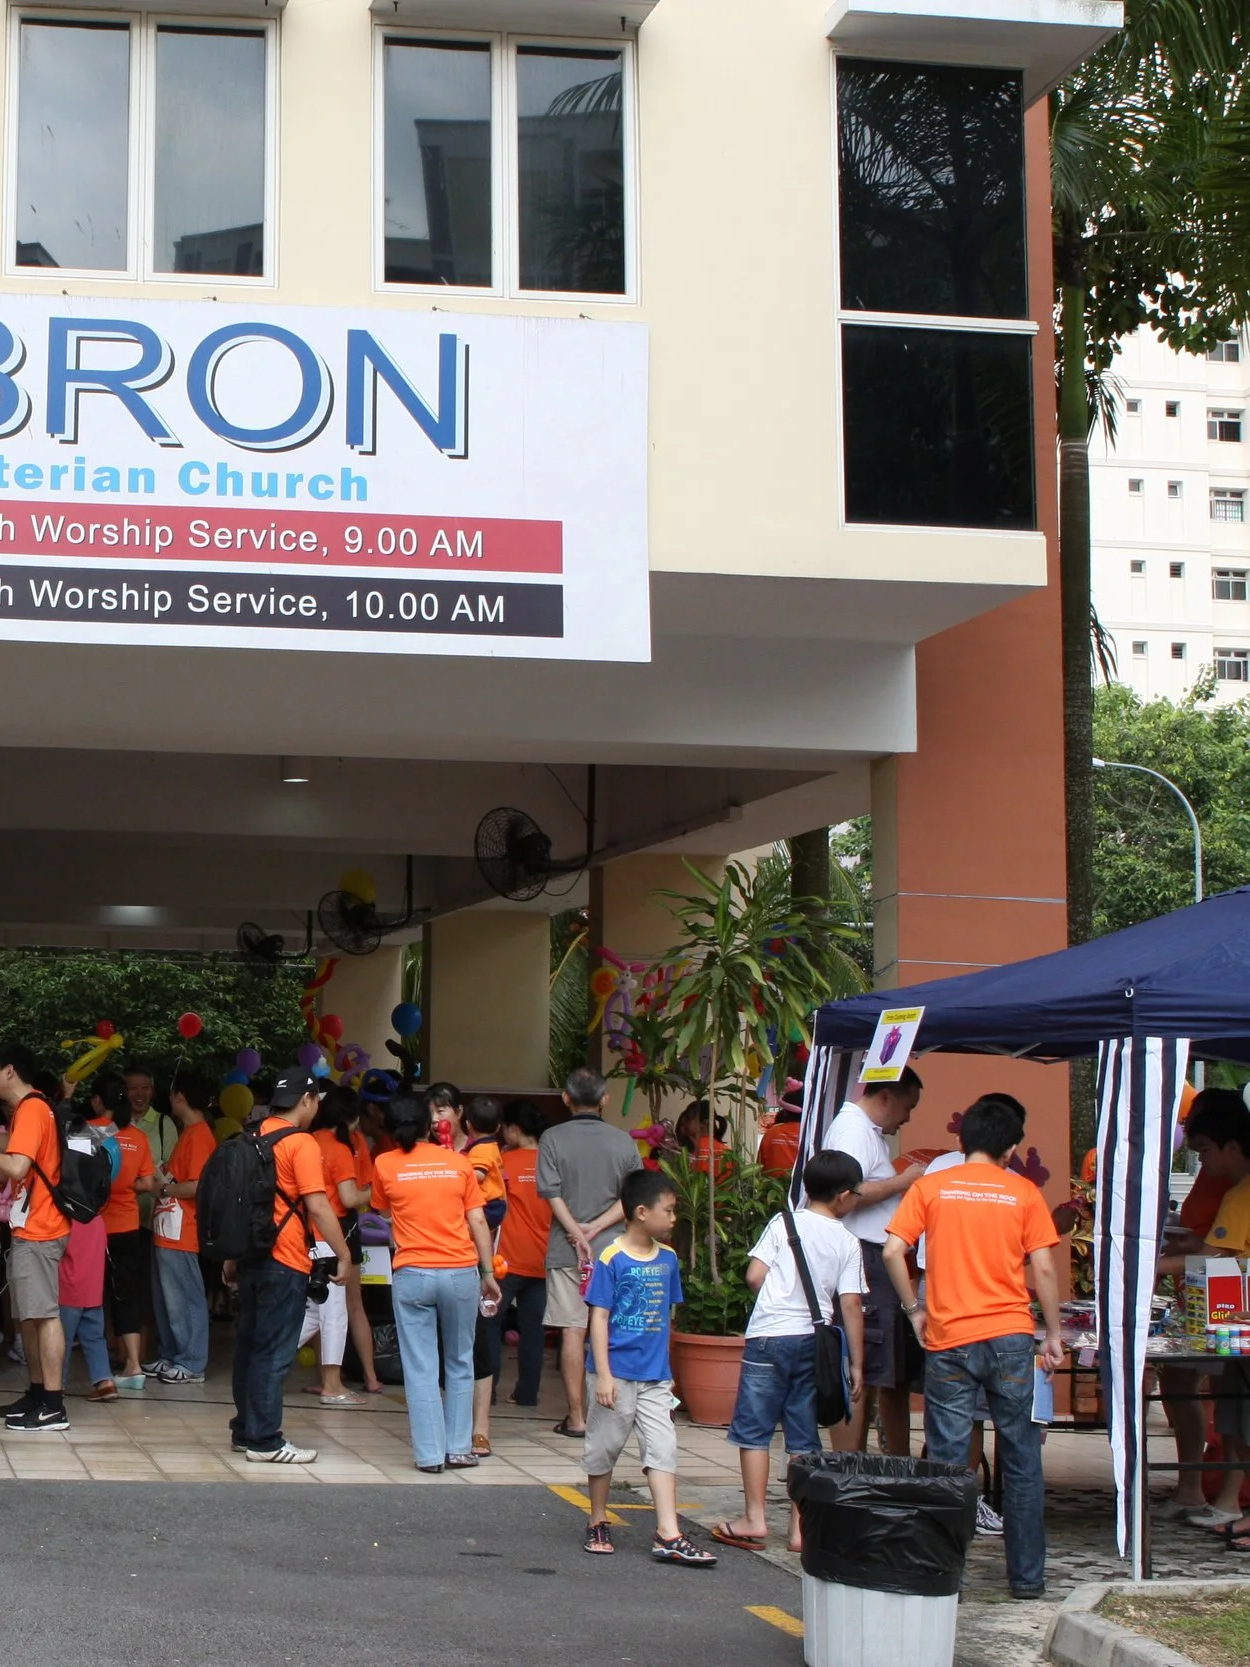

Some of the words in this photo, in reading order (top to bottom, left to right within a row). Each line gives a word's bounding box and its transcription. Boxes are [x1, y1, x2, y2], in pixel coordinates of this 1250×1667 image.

[178, 460, 368, 501] Church
[31, 514, 174, 553] Worship
[188, 519, 329, 556] Service,
[344, 526, 418, 555] 9.00
[430, 529, 484, 558] AM
[29, 578, 172, 618] Worship
[187, 584, 328, 622] Service,
[345, 590, 440, 621] 10.00
[451, 594, 506, 624] AM
